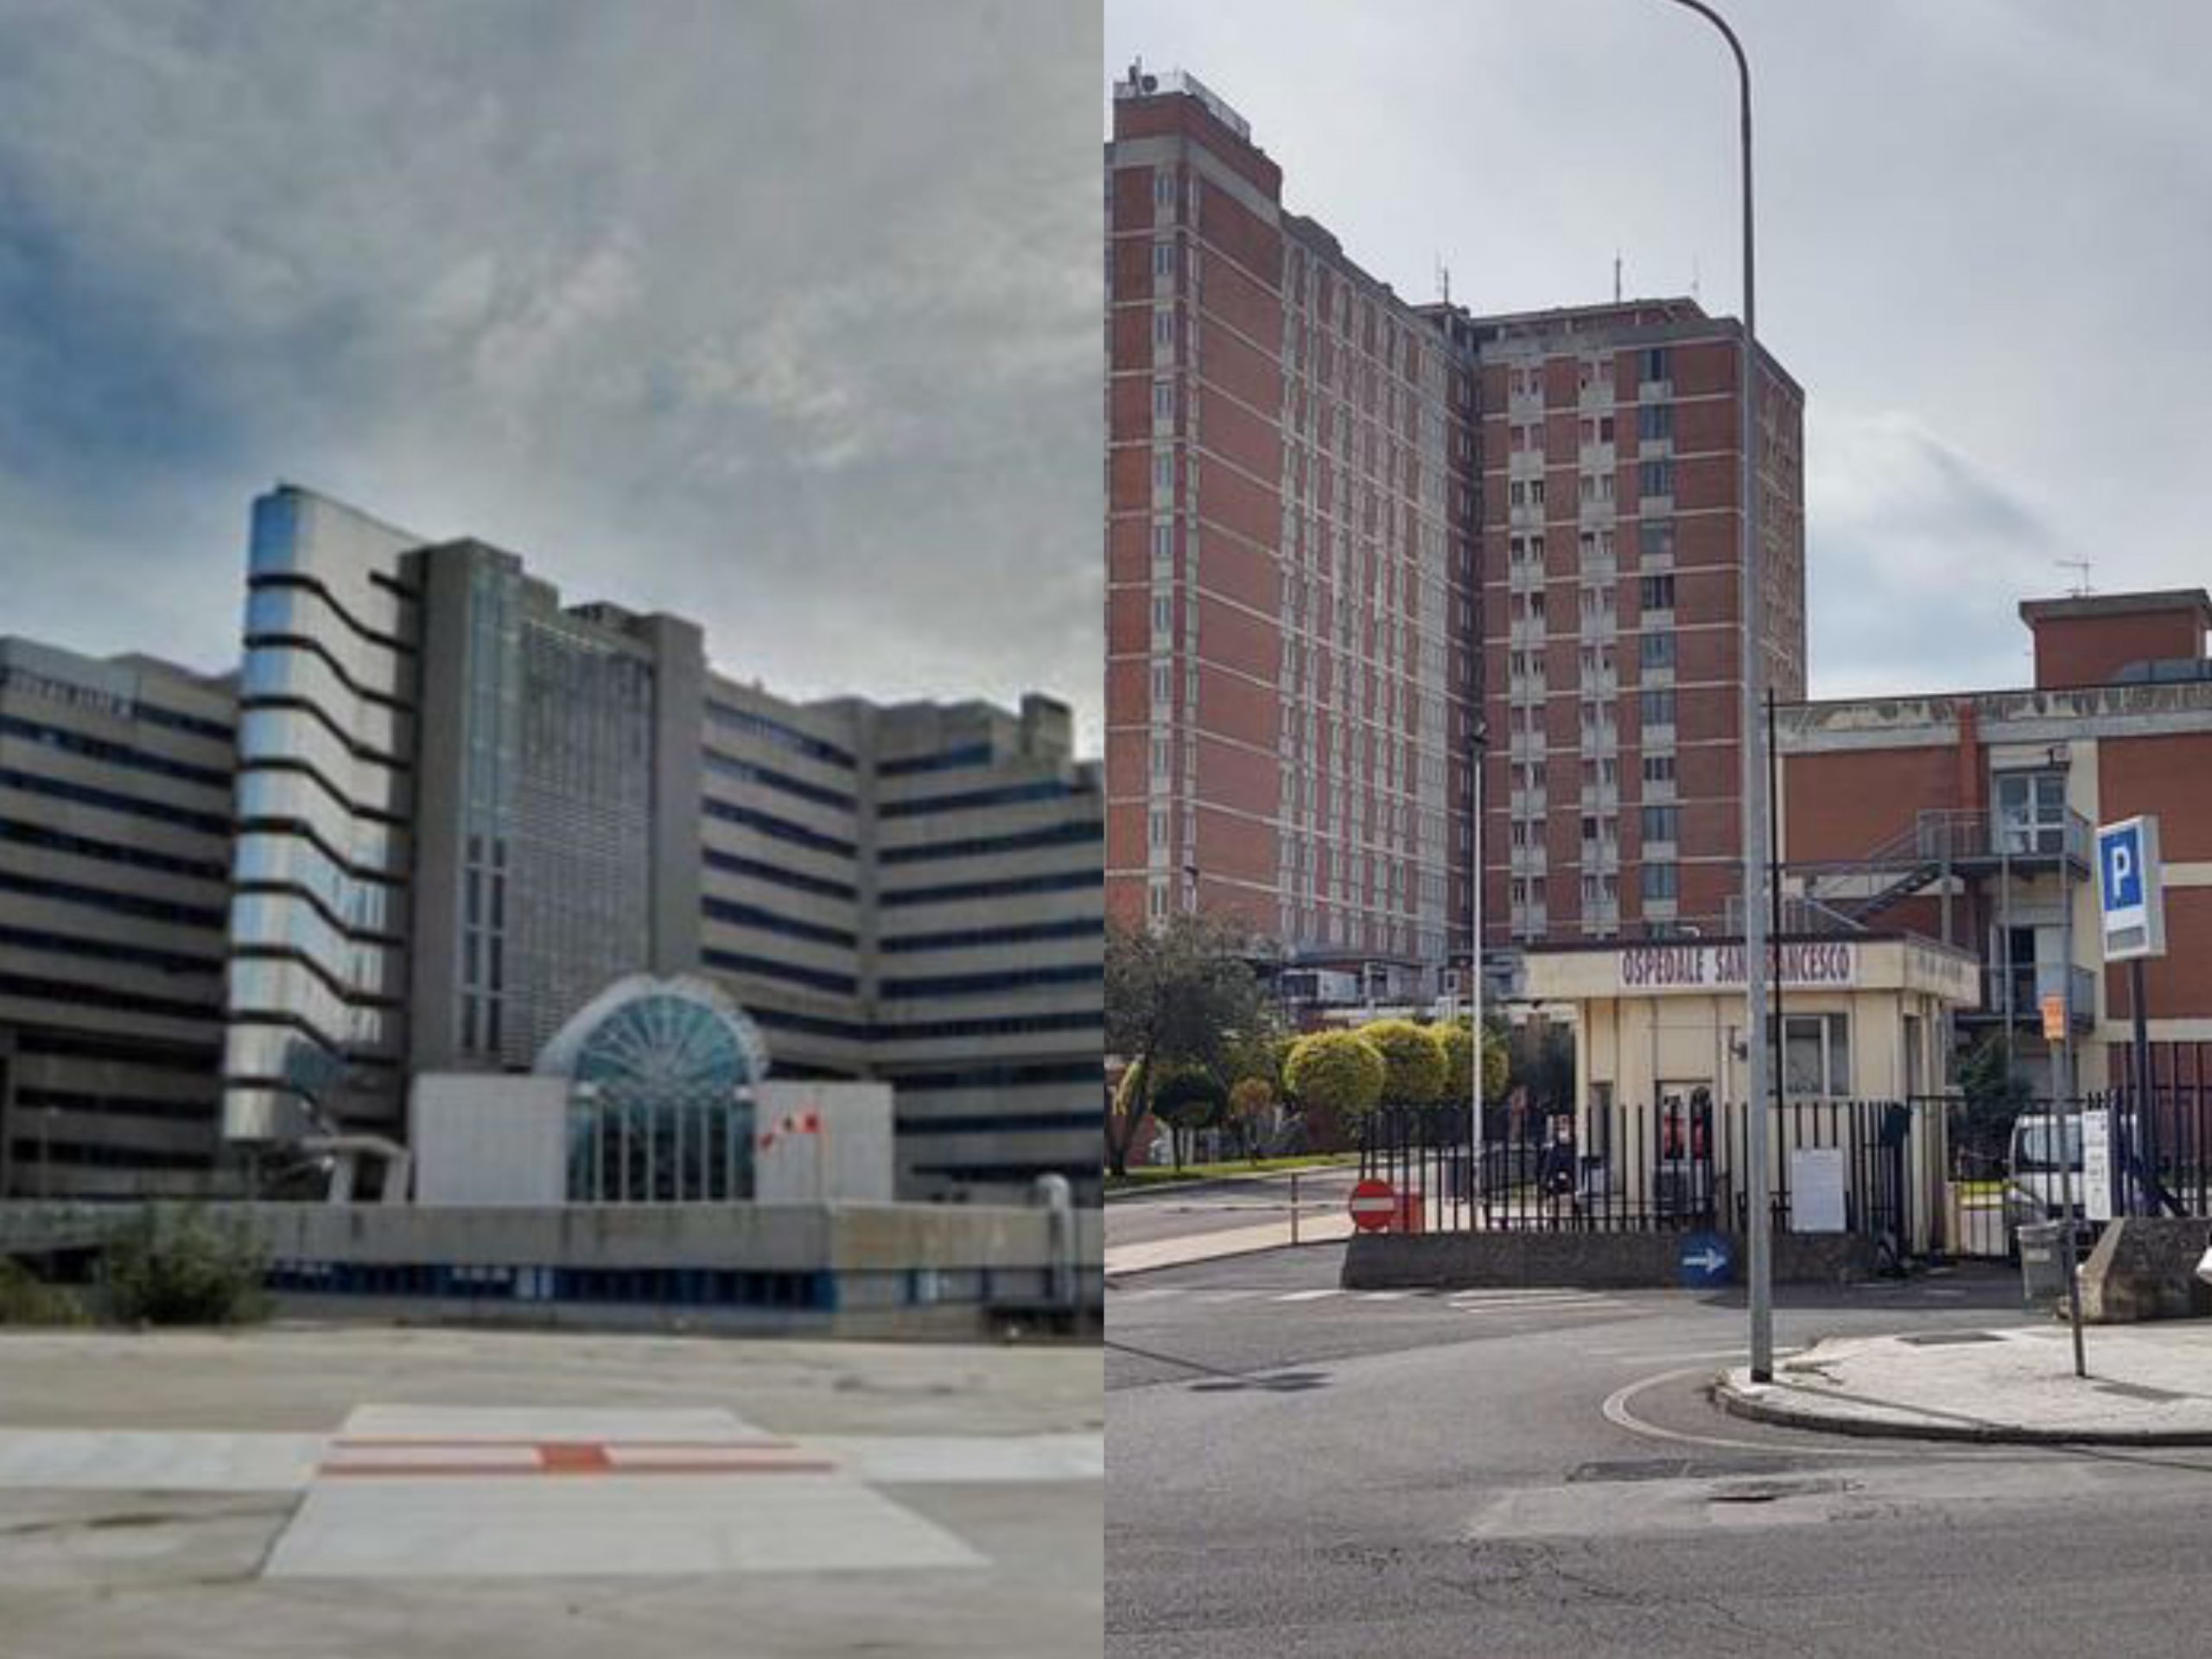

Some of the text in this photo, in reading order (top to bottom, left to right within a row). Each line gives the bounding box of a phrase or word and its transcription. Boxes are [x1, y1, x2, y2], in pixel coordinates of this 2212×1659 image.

[2112, 846, 2131, 899] P
[1623, 944, 1850, 984] OSPEDALE SAN RANCESCO
